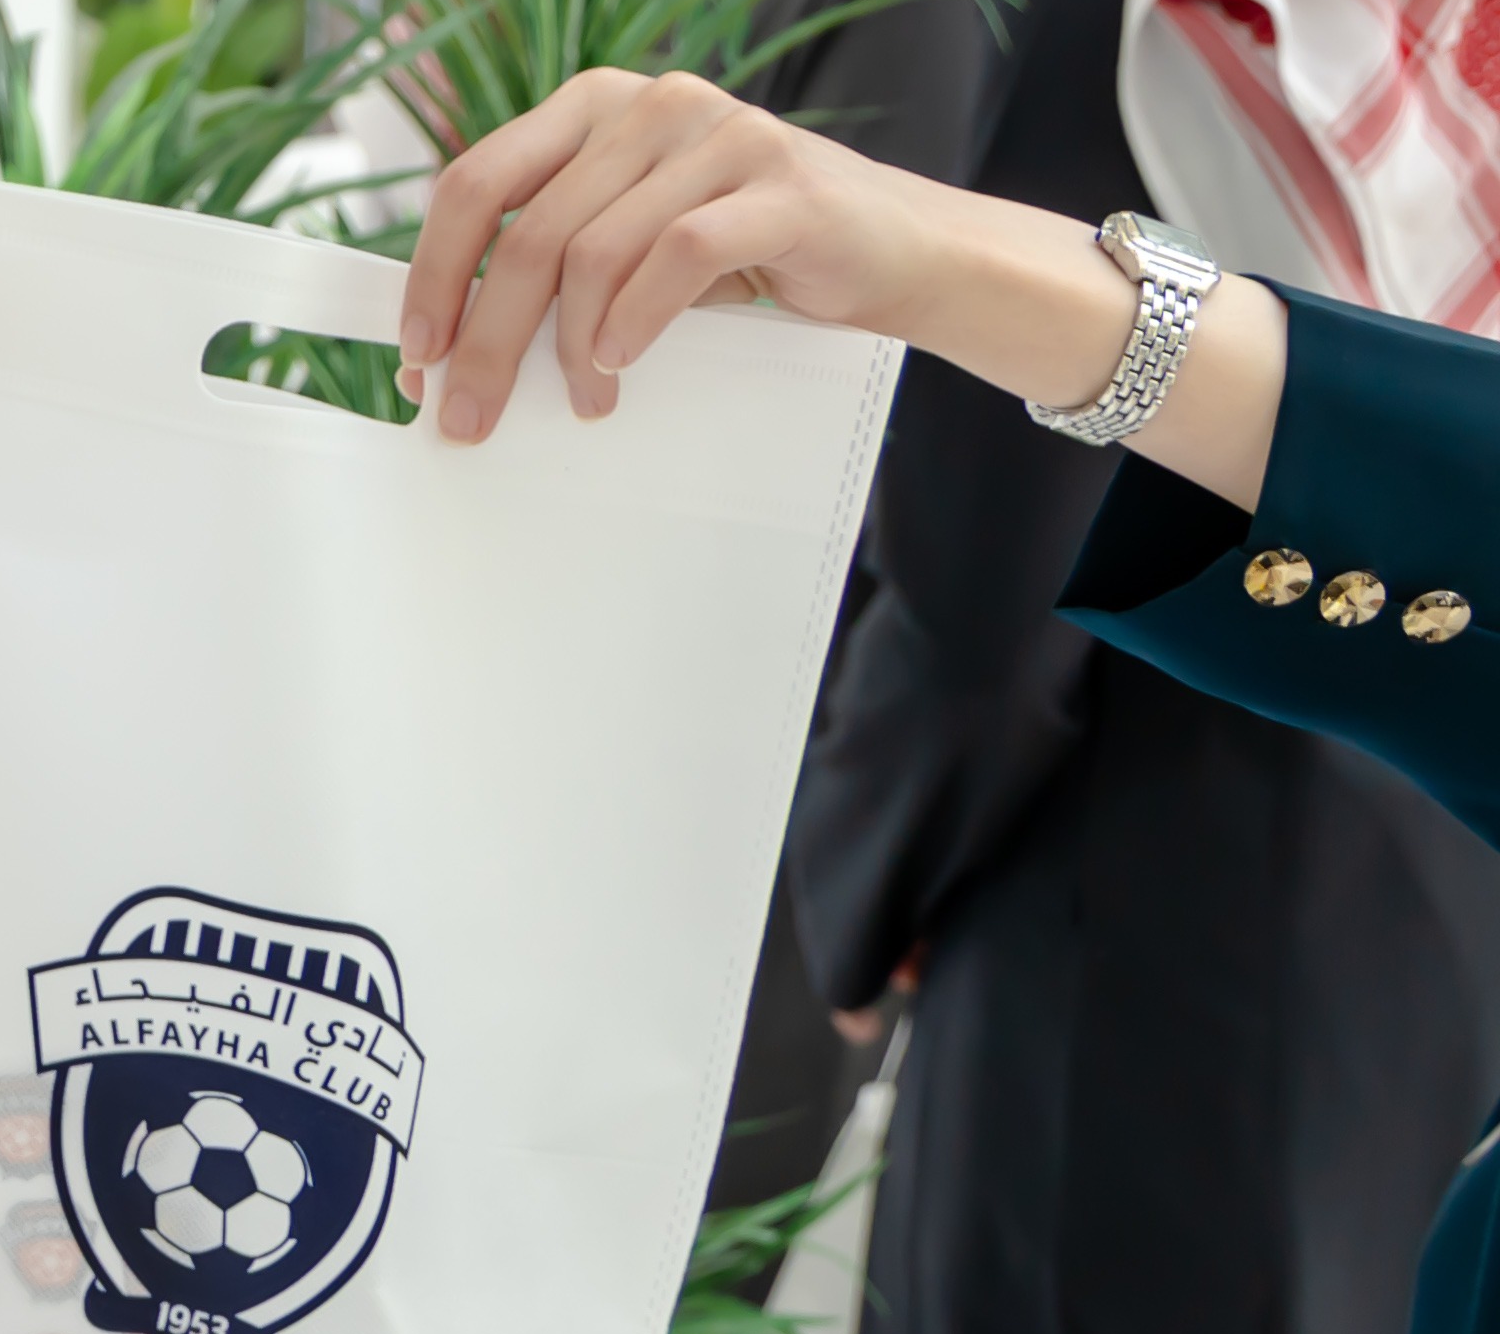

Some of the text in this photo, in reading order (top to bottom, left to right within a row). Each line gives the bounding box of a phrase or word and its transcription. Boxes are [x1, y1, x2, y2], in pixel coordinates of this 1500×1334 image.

[75, 968, 409, 1079] نادي الفيحاء
[80, 1019, 393, 1122] ALFAYHA CLUB
